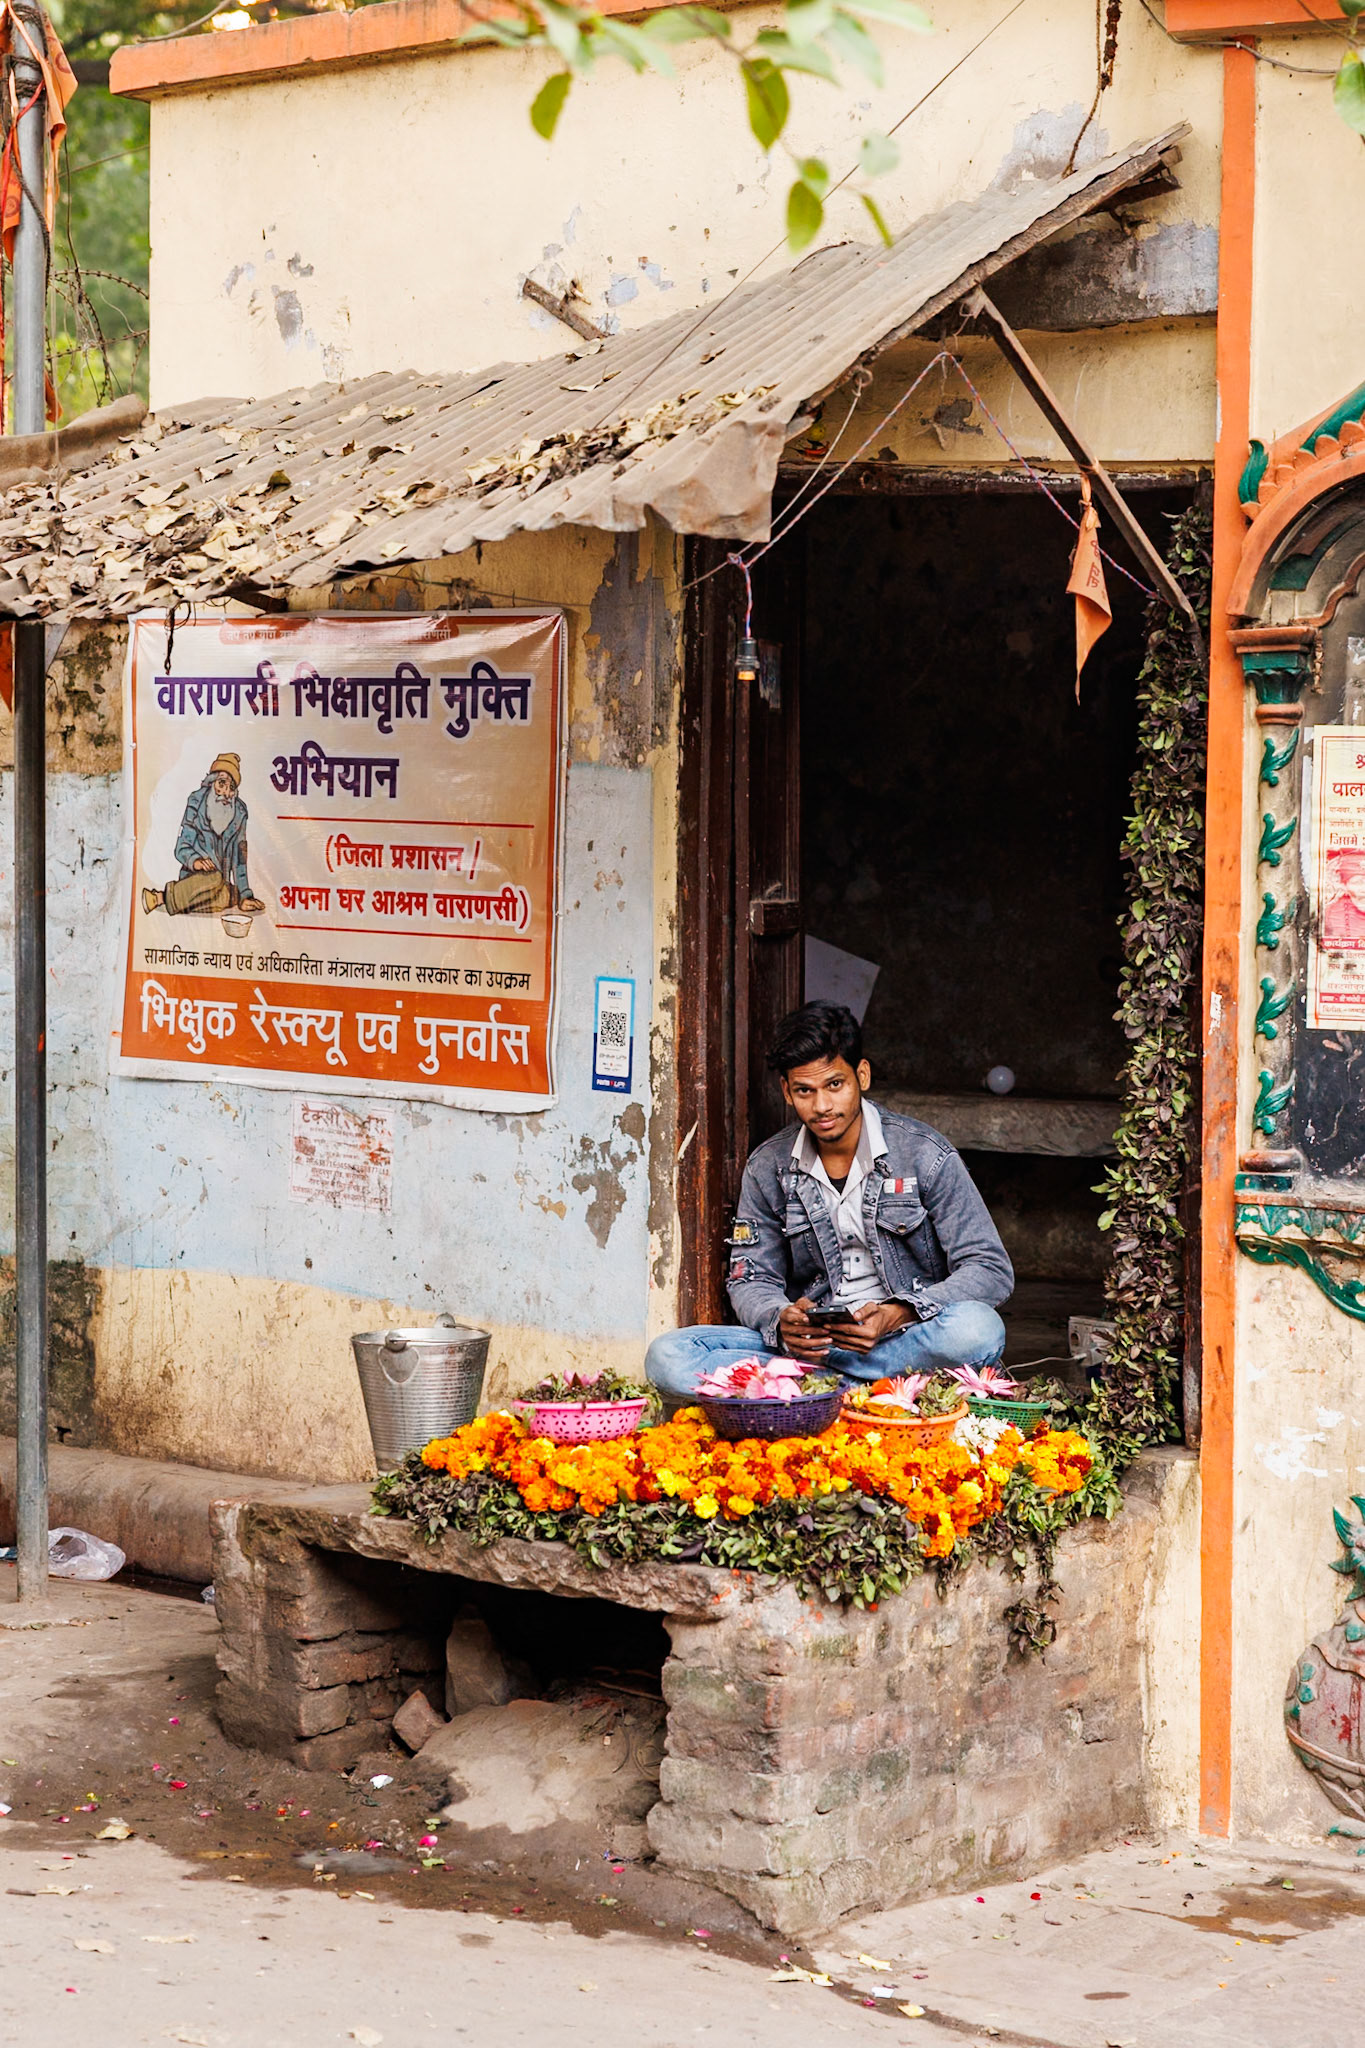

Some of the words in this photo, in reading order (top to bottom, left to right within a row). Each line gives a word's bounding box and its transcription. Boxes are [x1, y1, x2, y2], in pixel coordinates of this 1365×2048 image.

[154, 660, 279, 716] वाराणसी
[290, 661, 431, 734] भिक्षावृति
[440, 661, 531, 738] मुक्ति
[270, 740, 399, 799] अभियान
[1332, 782, 1365, 797] पाल
[326, 833, 384, 872] (जिला
[390, 845, 464, 871] प्रशासन
[280, 886, 331, 911] अपना
[337, 887, 365, 913] घर
[372, 890, 428, 917] आश्रम
[434, 887, 528, 929] वाराणसी)
[144, 944, 199, 967] सामाजिक
[203, 952, 232, 969] न्याय
[236, 952, 253, 971] एवं
[257, 951, 323, 976] अधिकारिता
[328, 957, 376, 979] मंत्रालय
[380, 964, 411, 982] भारत
[416, 966, 460, 985] सरकार
[464, 969, 482, 986] का
[486, 971, 531, 990] उपक्रम
[139, 979, 238, 1055] भिक्षुक
[249, 987, 348, 1067] रेस्क्यू
[356, 1000, 403, 1054] एवं
[414, 1003, 531, 1075] पुनर्वास
